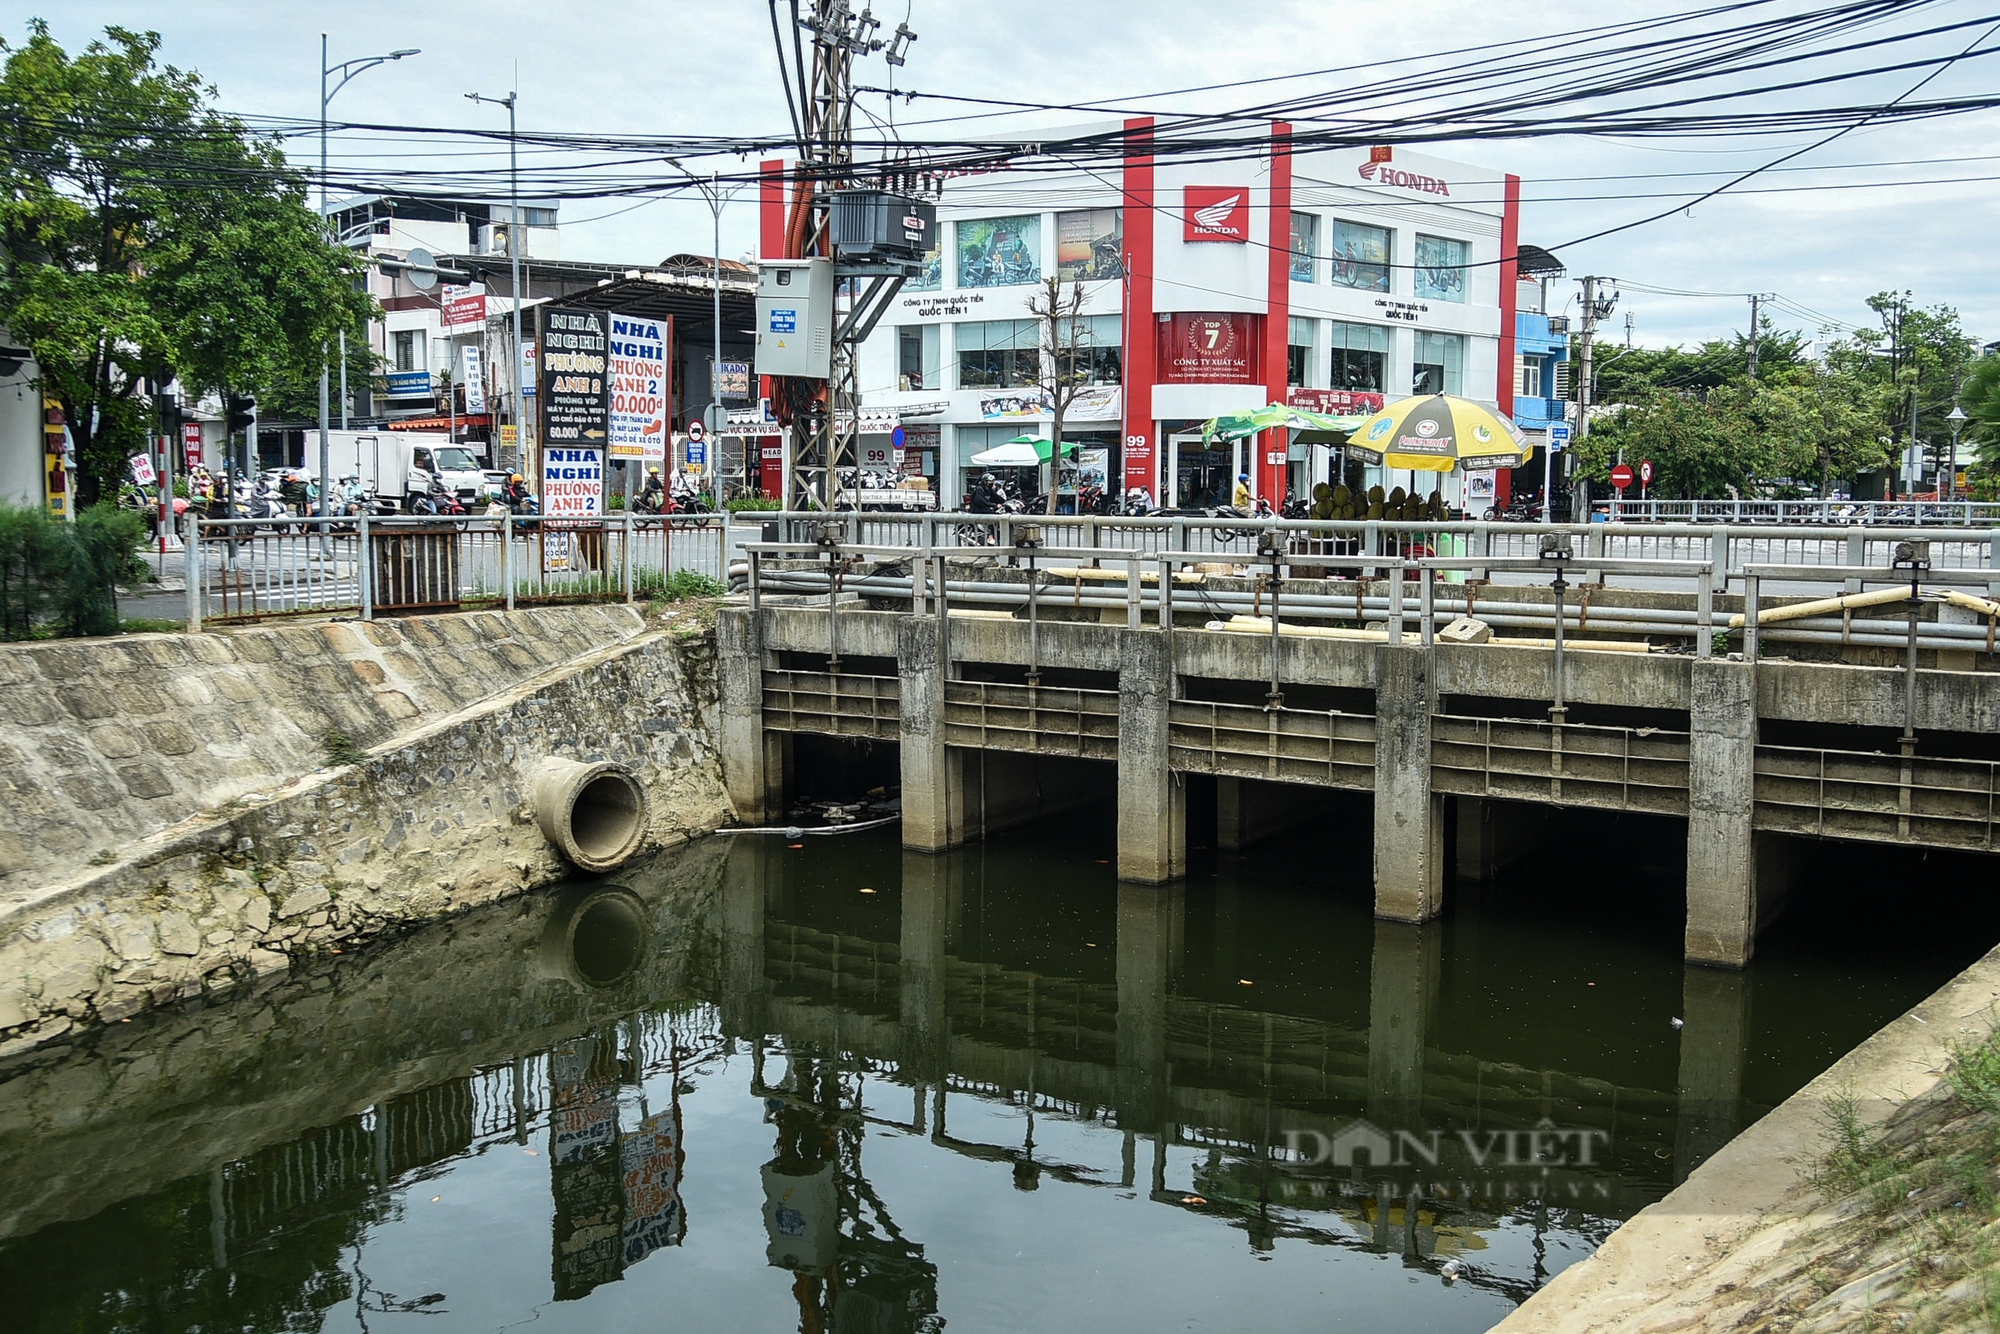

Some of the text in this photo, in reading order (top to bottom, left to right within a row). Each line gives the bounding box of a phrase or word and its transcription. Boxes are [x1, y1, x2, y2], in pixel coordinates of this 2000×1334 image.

[1380, 167, 1450, 196] HONDA
[950, 294, 968, 304] QUỐC
[1375, 298, 1387, 306] CÔNG
[919, 304, 942, 316] QUỐC
[944, 304, 961, 314] TIẾN
[1386, 308, 1401, 319] QUỐC
[551, 314, 601, 331] NHÀ
[613, 320, 660, 339] NHÀ
[546, 332, 604, 350] NGHỈ
[1205, 330, 1219, 348] 7
[610, 341, 662, 360] NGHỈ
[545, 351, 605, 373] PHƯƠNG
[1174, 357, 1198, 365] CÔNG
[1212, 357, 1232, 365] XUẤT
[714, 364, 747, 373] IKADO
[553, 376, 601, 394] ANH 2
[614, 377, 657, 394] ANH 2
[554, 395, 598, 405] PHÒNG VÍP
[547, 405, 563, 413] MÁY
[186, 426, 199, 436] BAO
[731, 426, 742, 435] VỰC
[759, 426, 767, 434] VỤ
[879, 422, 892, 431] TIẾN
[186, 441, 199, 451] CAO
[1127, 436, 1145, 446] 99
[189, 456, 198, 465] SU
[868, 450, 885, 461] 99
[546, 463, 600, 479] NGHỈ
[546, 482, 600, 495] PHƯƠNG
[552, 498, 594, 510] ANH 2
